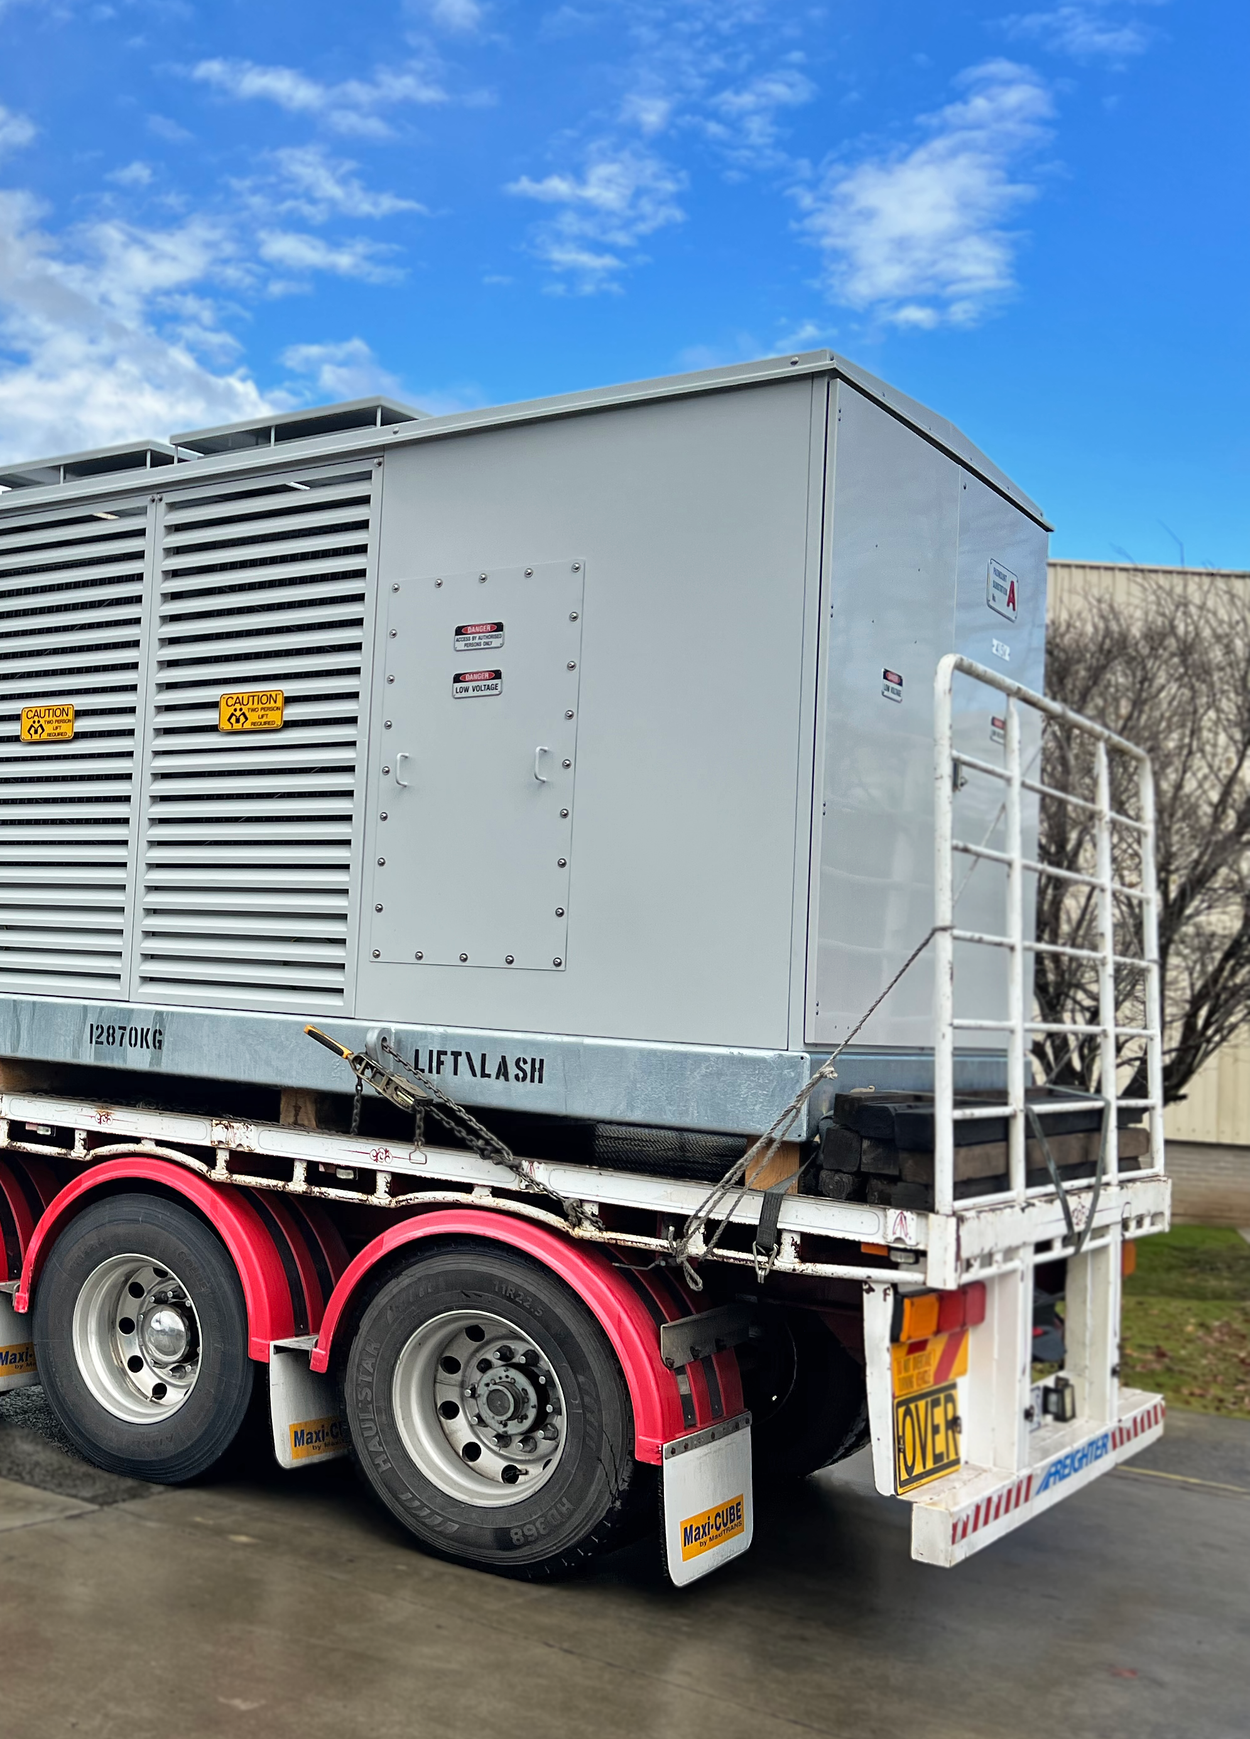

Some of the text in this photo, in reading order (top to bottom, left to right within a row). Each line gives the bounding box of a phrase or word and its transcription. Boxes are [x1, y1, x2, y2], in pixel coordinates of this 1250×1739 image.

[467, 625, 491, 633] DANGER
[455, 683, 499, 694] LOW VOLTAGE
[465, 672, 489, 681] DANGER
[26, 707, 70, 720] CAUTION
[225, 693, 278, 707] CAUTION
[89, 1023, 163, 1050] 12870KG
[293, 1421, 343, 1448] Maxi-C
[902, 1392, 959, 1477] OVER
[1038, 1432, 1109, 1494] FREIGHTER
[683, 1501, 742, 1548] Maxi-CUBE
[699, 1520, 743, 1548] by MaxiTRANS
